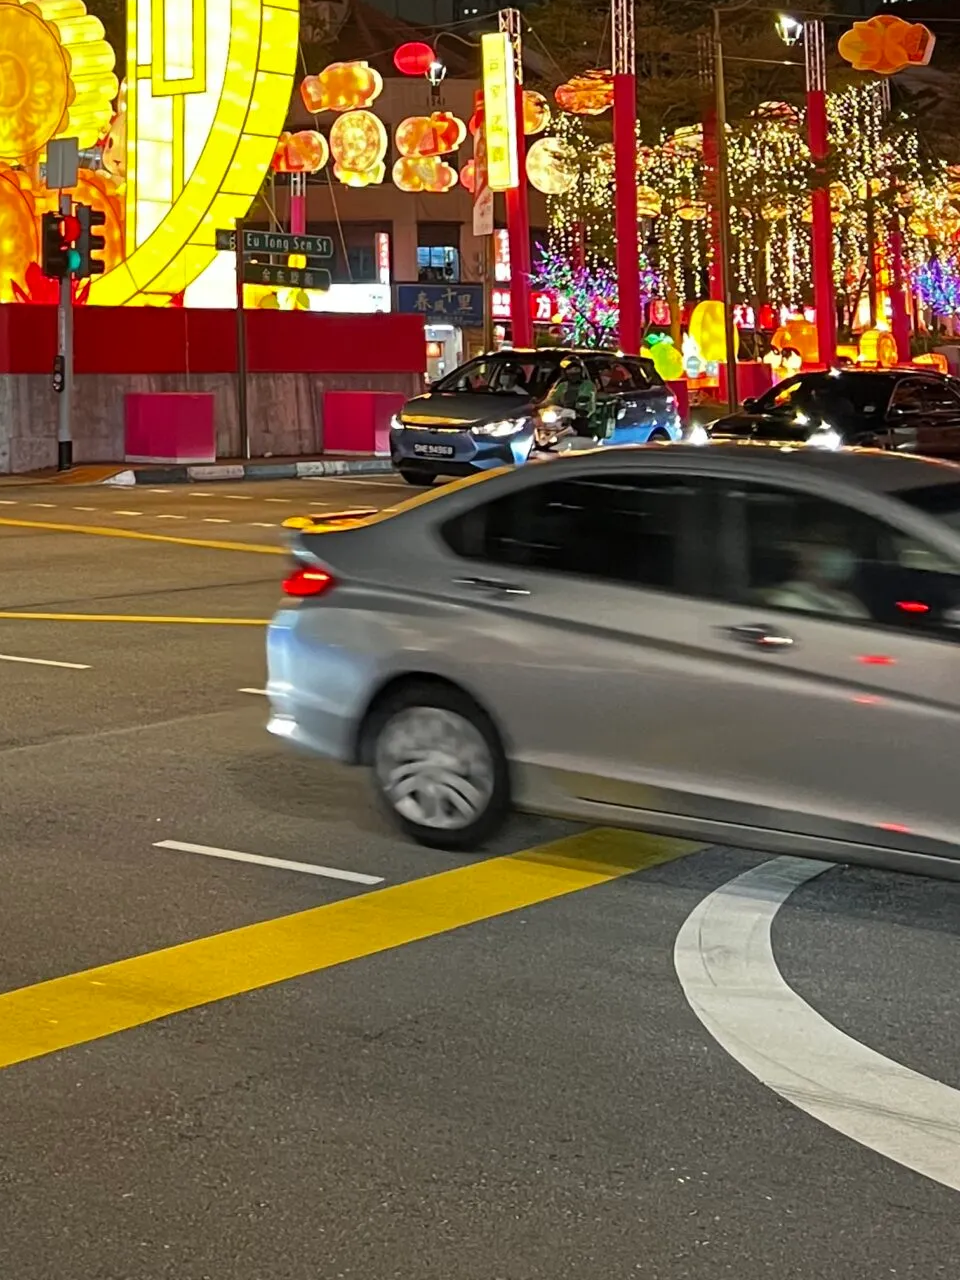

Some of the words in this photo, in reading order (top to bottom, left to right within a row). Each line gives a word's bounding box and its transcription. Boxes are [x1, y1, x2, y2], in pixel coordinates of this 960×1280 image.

[247, 234, 260, 247] Eu
[264, 235, 289, 252] Tong
[294, 238, 312, 251] Sen
[317, 239, 327, 252] St
